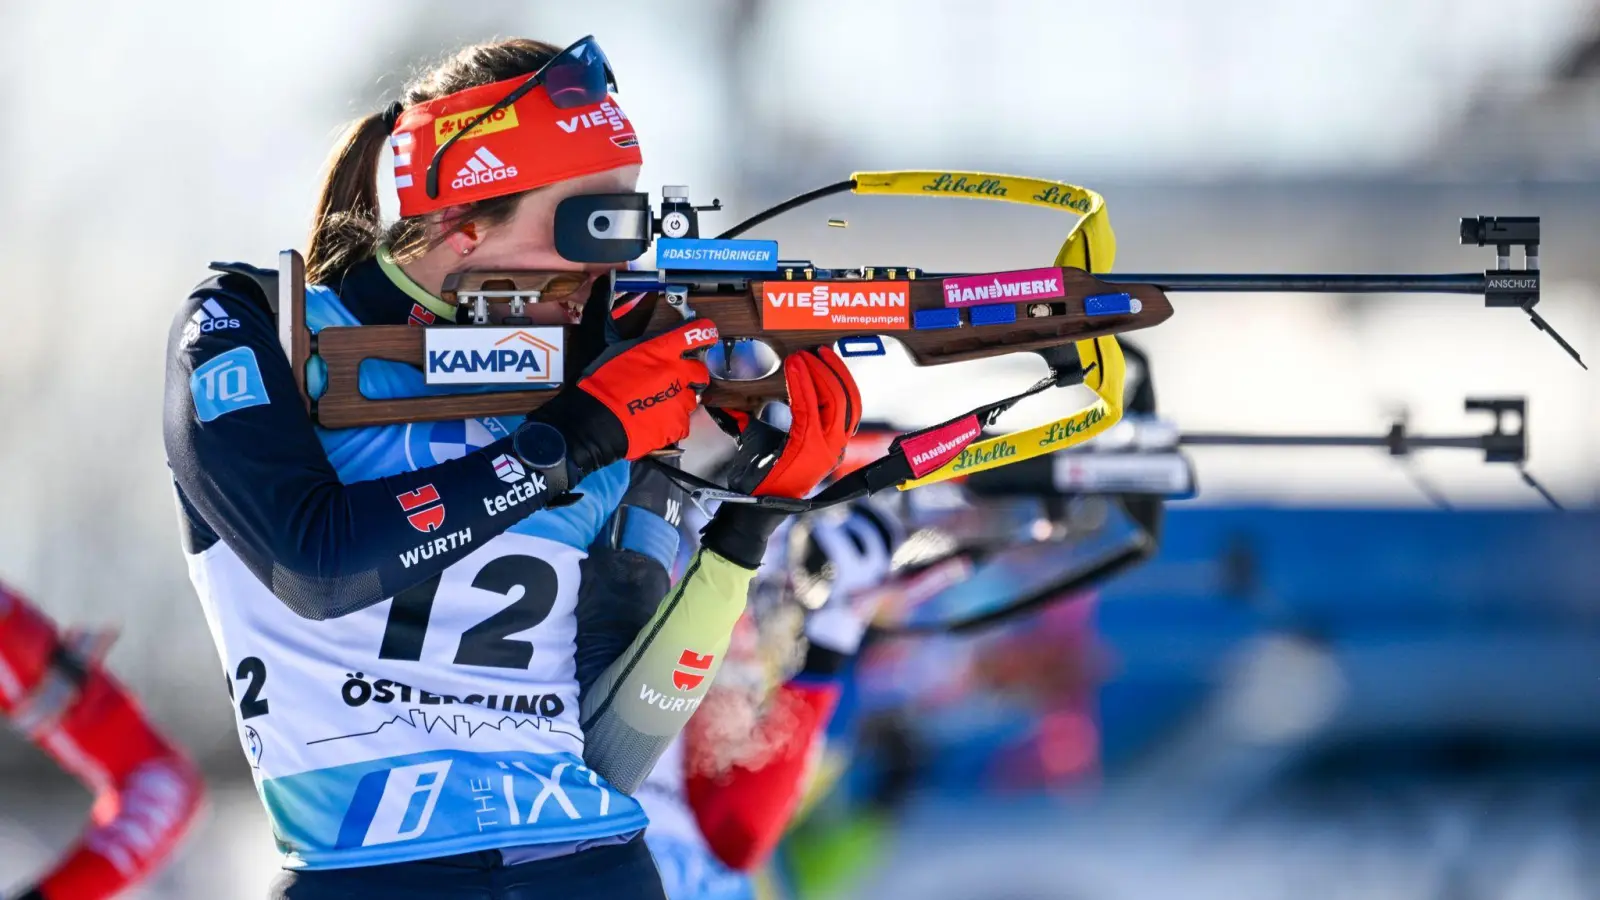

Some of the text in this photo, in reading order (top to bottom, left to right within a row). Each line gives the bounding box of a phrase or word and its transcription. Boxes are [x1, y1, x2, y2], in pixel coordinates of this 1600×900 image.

[451, 166, 518, 189] adidas
[922, 173, 1008, 197] Libella
[663, 248, 770, 261] #DASISTTHÜRINGEN
[767, 286, 905, 316] VIESSMANN
[948, 278, 1058, 303] HANDWERK
[831, 314, 905, 325] Wärmepumpen
[429, 349, 540, 373] KAMPA
[199, 360, 257, 402] TQ
[953, 441, 1017, 472] Libella
[483, 472, 547, 516] tectak
[399, 527, 472, 568] WÜRTH
[470, 777, 498, 832] THE
